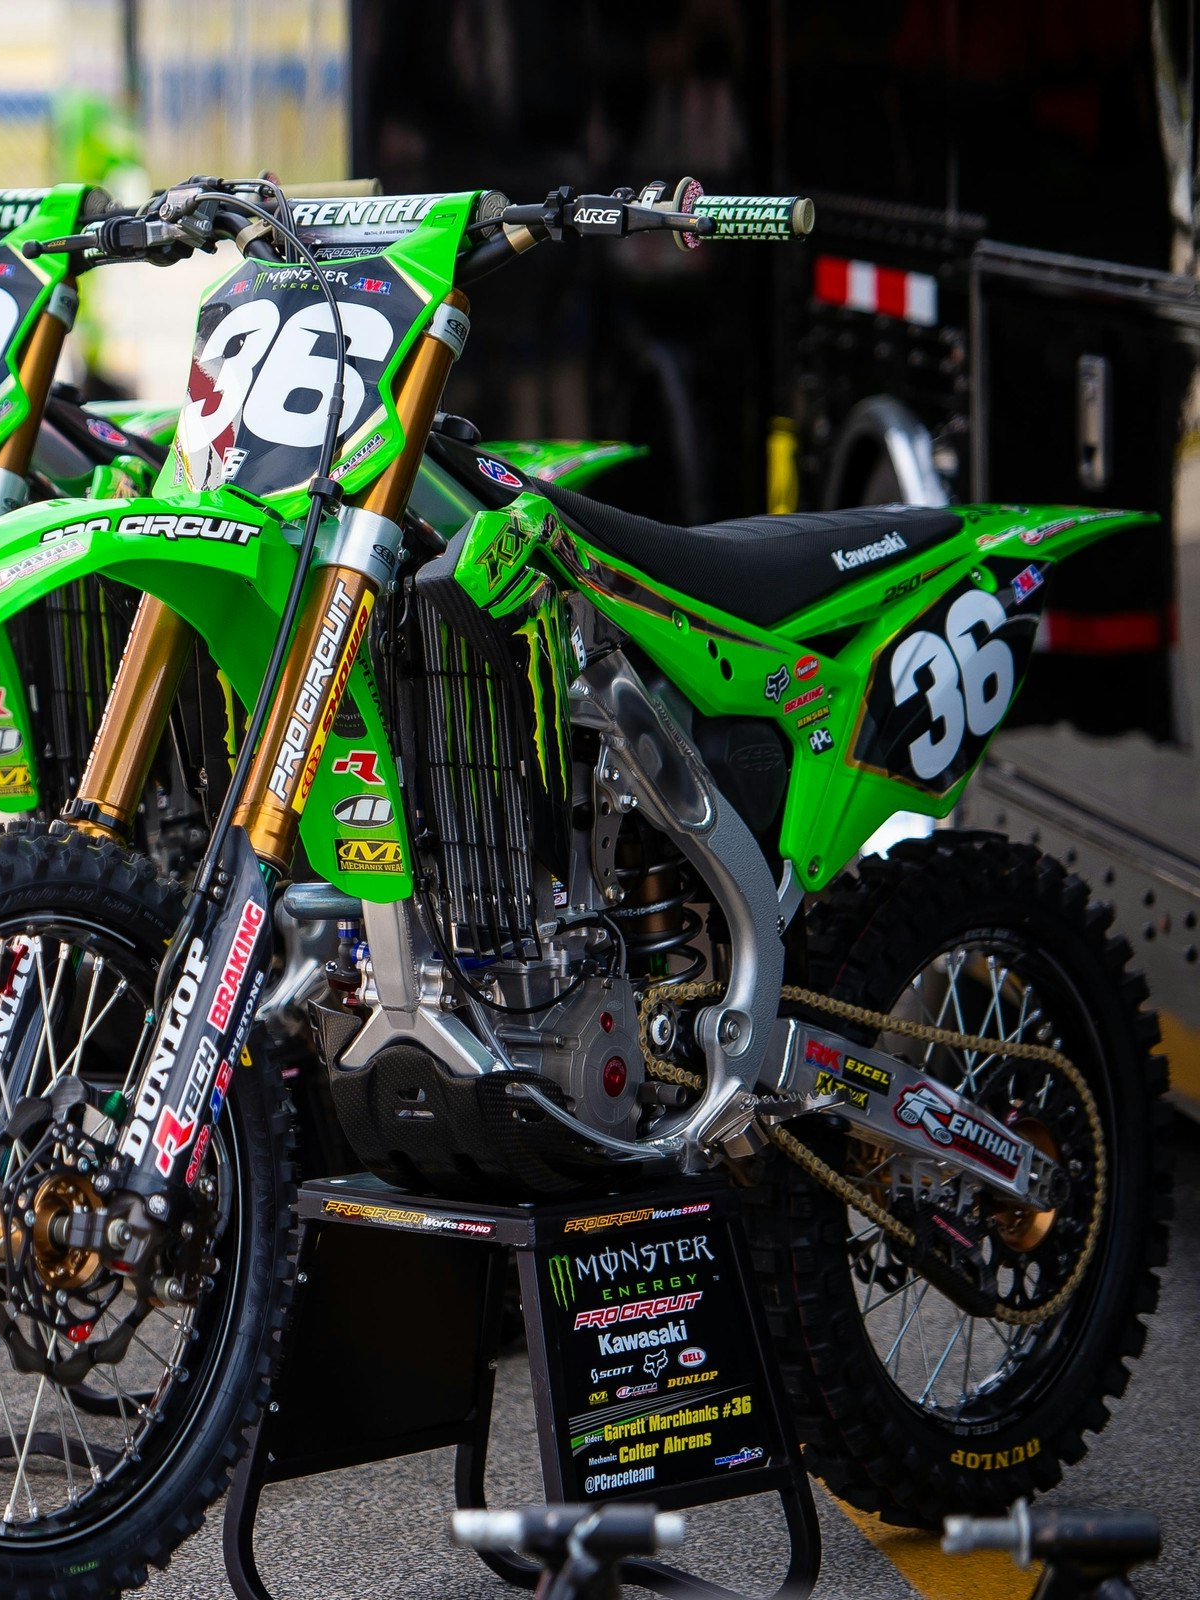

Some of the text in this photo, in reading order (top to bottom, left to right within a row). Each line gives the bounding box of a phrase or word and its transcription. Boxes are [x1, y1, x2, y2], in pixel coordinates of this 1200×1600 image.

[292, 197, 442, 226] RENTHA
[574, 208, 621, 224] ARC
[714, 223, 791, 235] ENTHAL
[272, 283, 320, 291] ENERG
[349, 276, 392, 295] AMA
[182, 298, 394, 455] 36
[116, 514, 260, 544] CIRCUIT
[831, 531, 906, 572] Kawasaki
[879, 573, 923, 606] 250
[321, 604, 368, 735] SHOWA
[891, 589, 1015, 779] 36
[268, 578, 353, 802] PRO CIRCUIT
[783, 685, 825, 714] BRAKING
[808, 728, 832, 750] PPG
[340, 860, 382, 872] MECHANIX
[208, 899, 265, 1034] BRAKING
[228, 970, 264, 1066] PISTONS
[123, 937, 204, 1167] DUNLOP
[806, 1039, 842, 1070] RK
[845, 1057, 890, 1086] EXCEL
[326, 1201, 361, 1215] PRO
[362, 1204, 427, 1224] CIRCUIT
[457, 1223, 491, 1234] STAND
[564, 1217, 597, 1233] PRO
[598, 1207, 654, 1228] CIRCUIT
[681, 1203, 711, 1215] STAND
[602, 1273, 698, 1301] ENERGY
[574, 1291, 704, 1331] PRO CIRCUIT
[598, 1319, 688, 1356] Kawasaki
[599, 1364, 635, 1379] SCOTT
[681, 1351, 703, 1364] BELL
[666, 1370, 719, 1389] DUNLOP
[584, 1395, 752, 1445] Rider: Garrett Marchbanks #36
[618, 1441, 660, 1464] Colter
[662, 1432, 713, 1455] Ahrens
[950, 1437, 1042, 1471] DUNLOP
[584, 1465, 656, 1494] @PCraceteam
